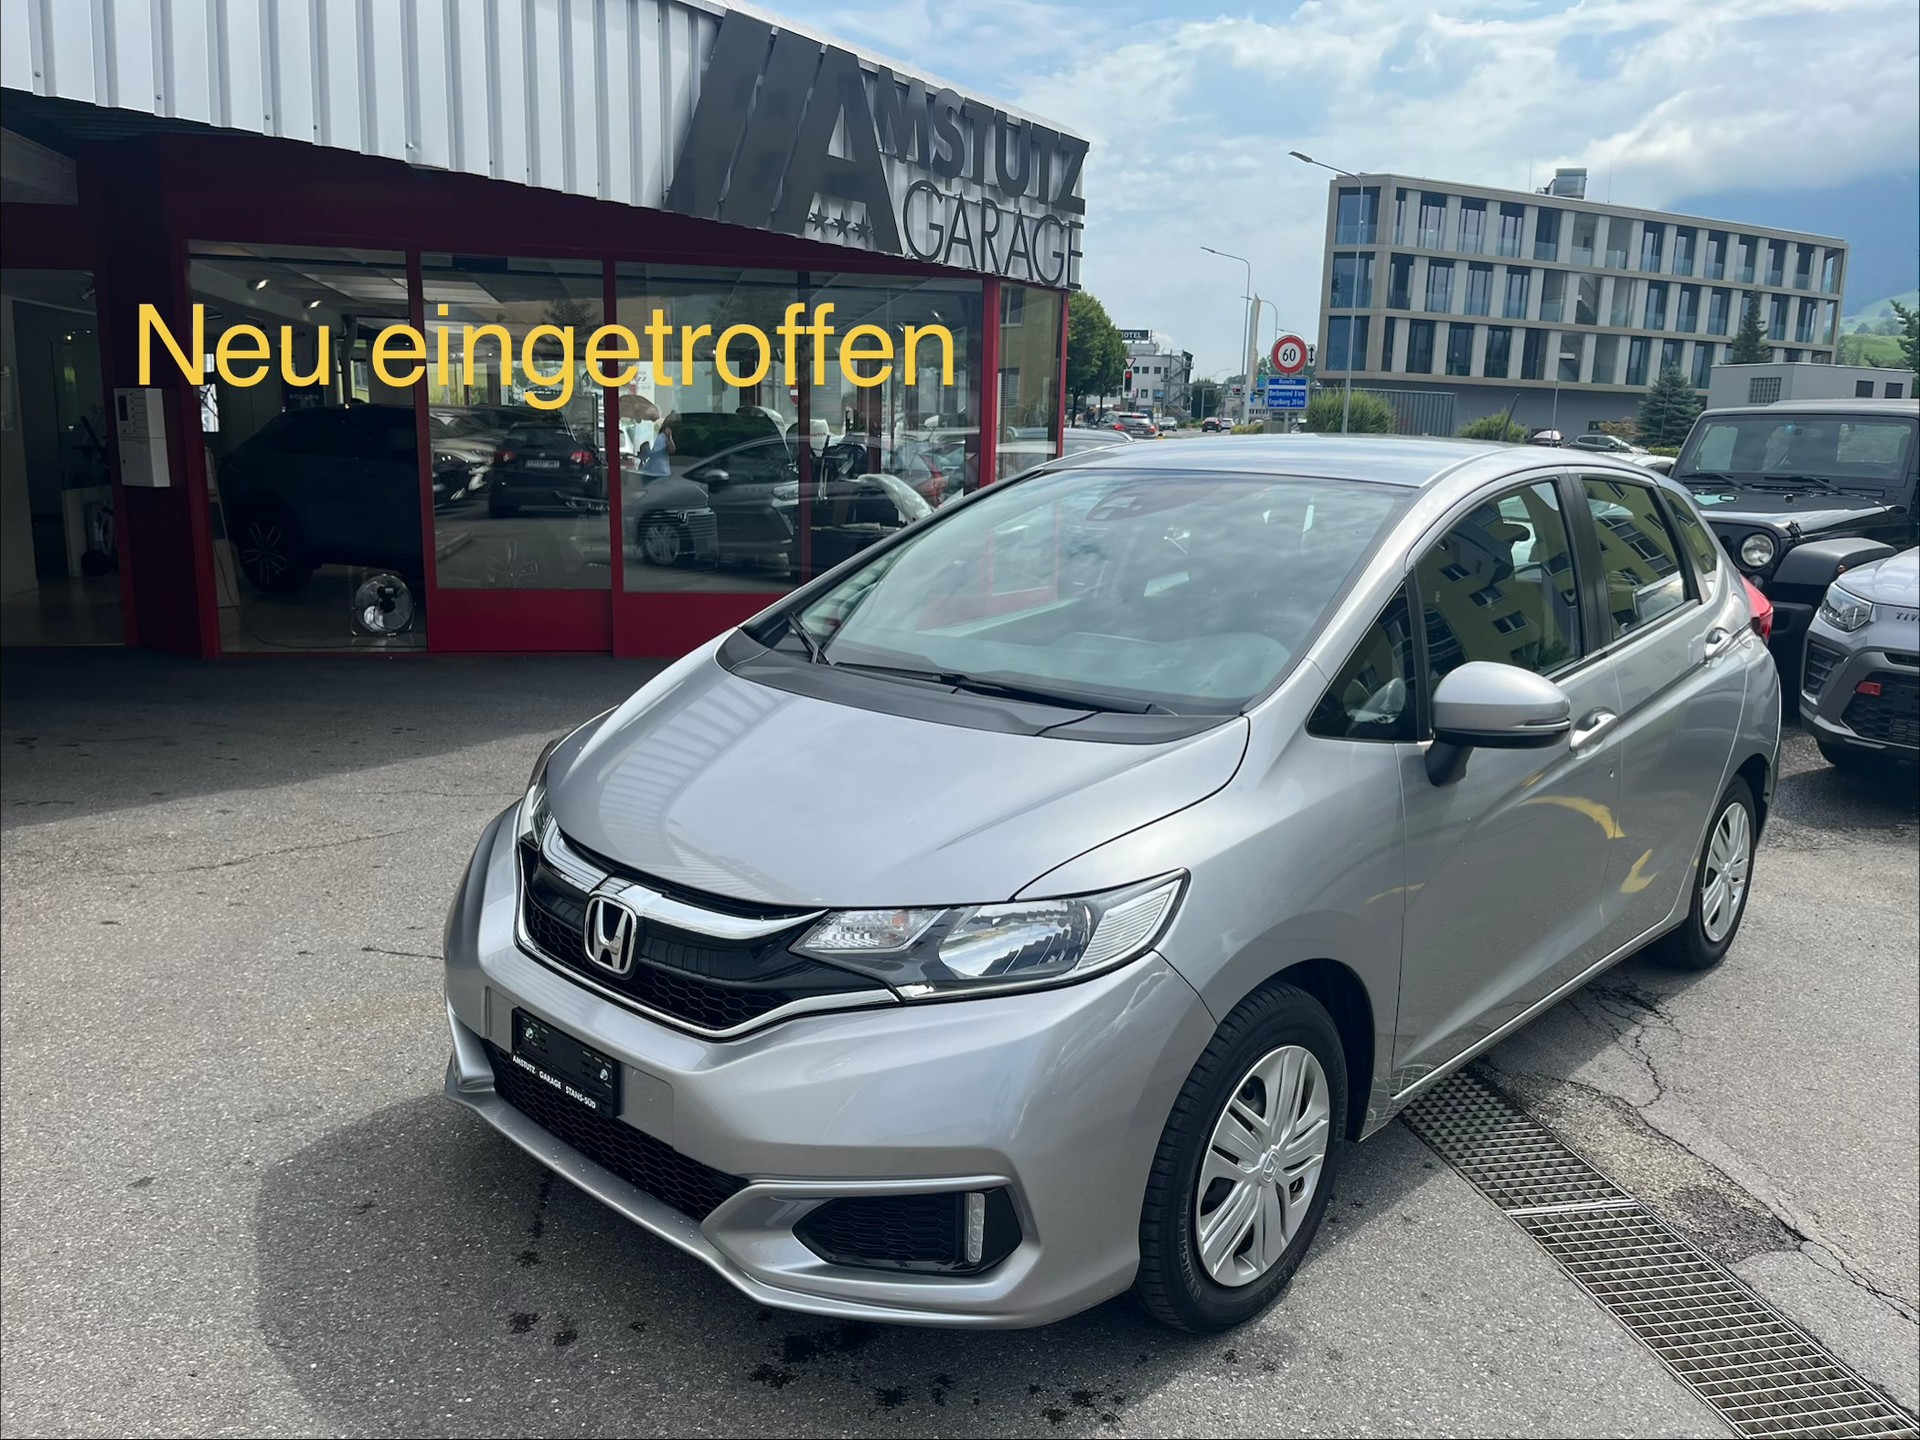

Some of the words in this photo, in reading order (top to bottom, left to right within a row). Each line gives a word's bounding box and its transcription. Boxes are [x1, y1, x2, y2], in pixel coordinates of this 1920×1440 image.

[771, 44, 1089, 256] AMSTUTZ
[903, 180, 1084, 289] GARAGE
[1282, 348, 1296, 361] 60
[512, 1055, 536, 1074] AMSTUTZ
[539, 1070, 562, 1090] GARAGE
[565, 1086, 596, 1109] STANS-SÜD
